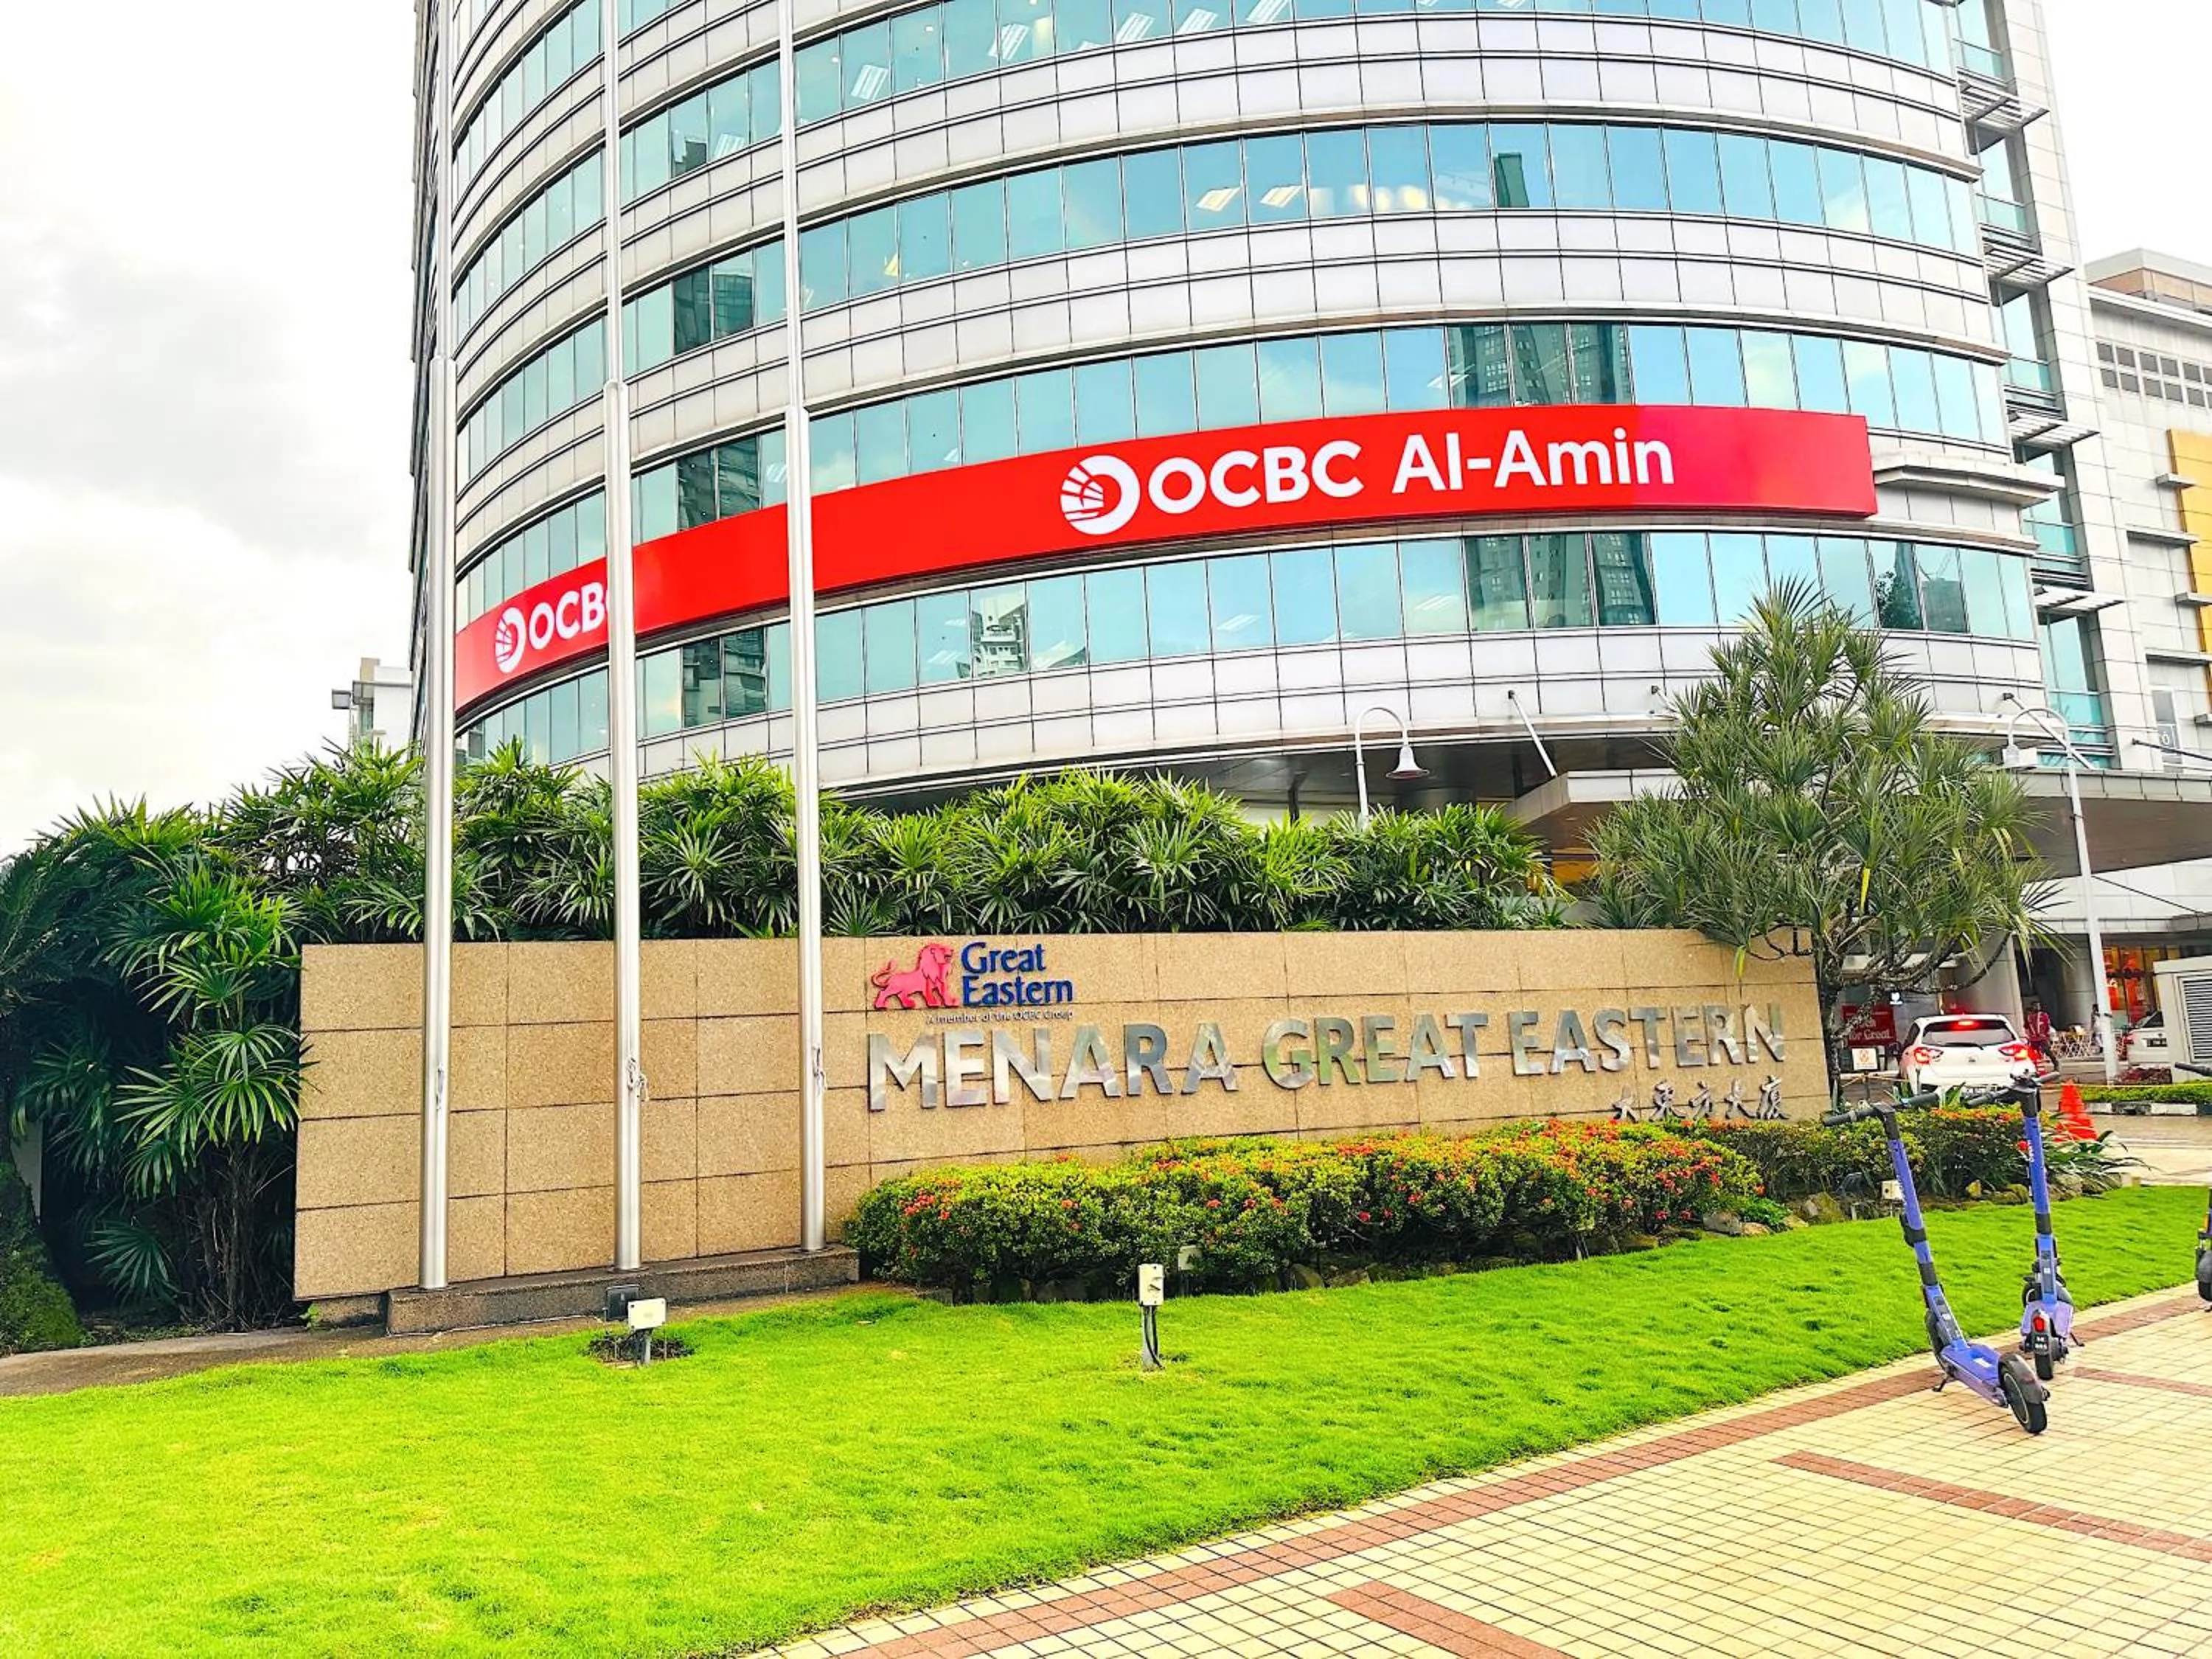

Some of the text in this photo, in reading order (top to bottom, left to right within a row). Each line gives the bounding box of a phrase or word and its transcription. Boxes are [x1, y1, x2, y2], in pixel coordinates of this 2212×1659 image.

[1148, 428, 1674, 514] OCBC Al-Amin
[528, 581, 608, 650] OCB
[961, 942, 1046, 974] Great
[936, 1012, 980, 1024] member
[981, 1012, 995, 1023] of
[995, 1011, 1012, 1022] the
[1013, 1010, 1041, 1021] OCBC
[1043, 1010, 1074, 1022] Group
[961, 975, 1074, 1008] Eastern
[869, 1001, 1786, 1111] MENARA GREAT EASTERN
